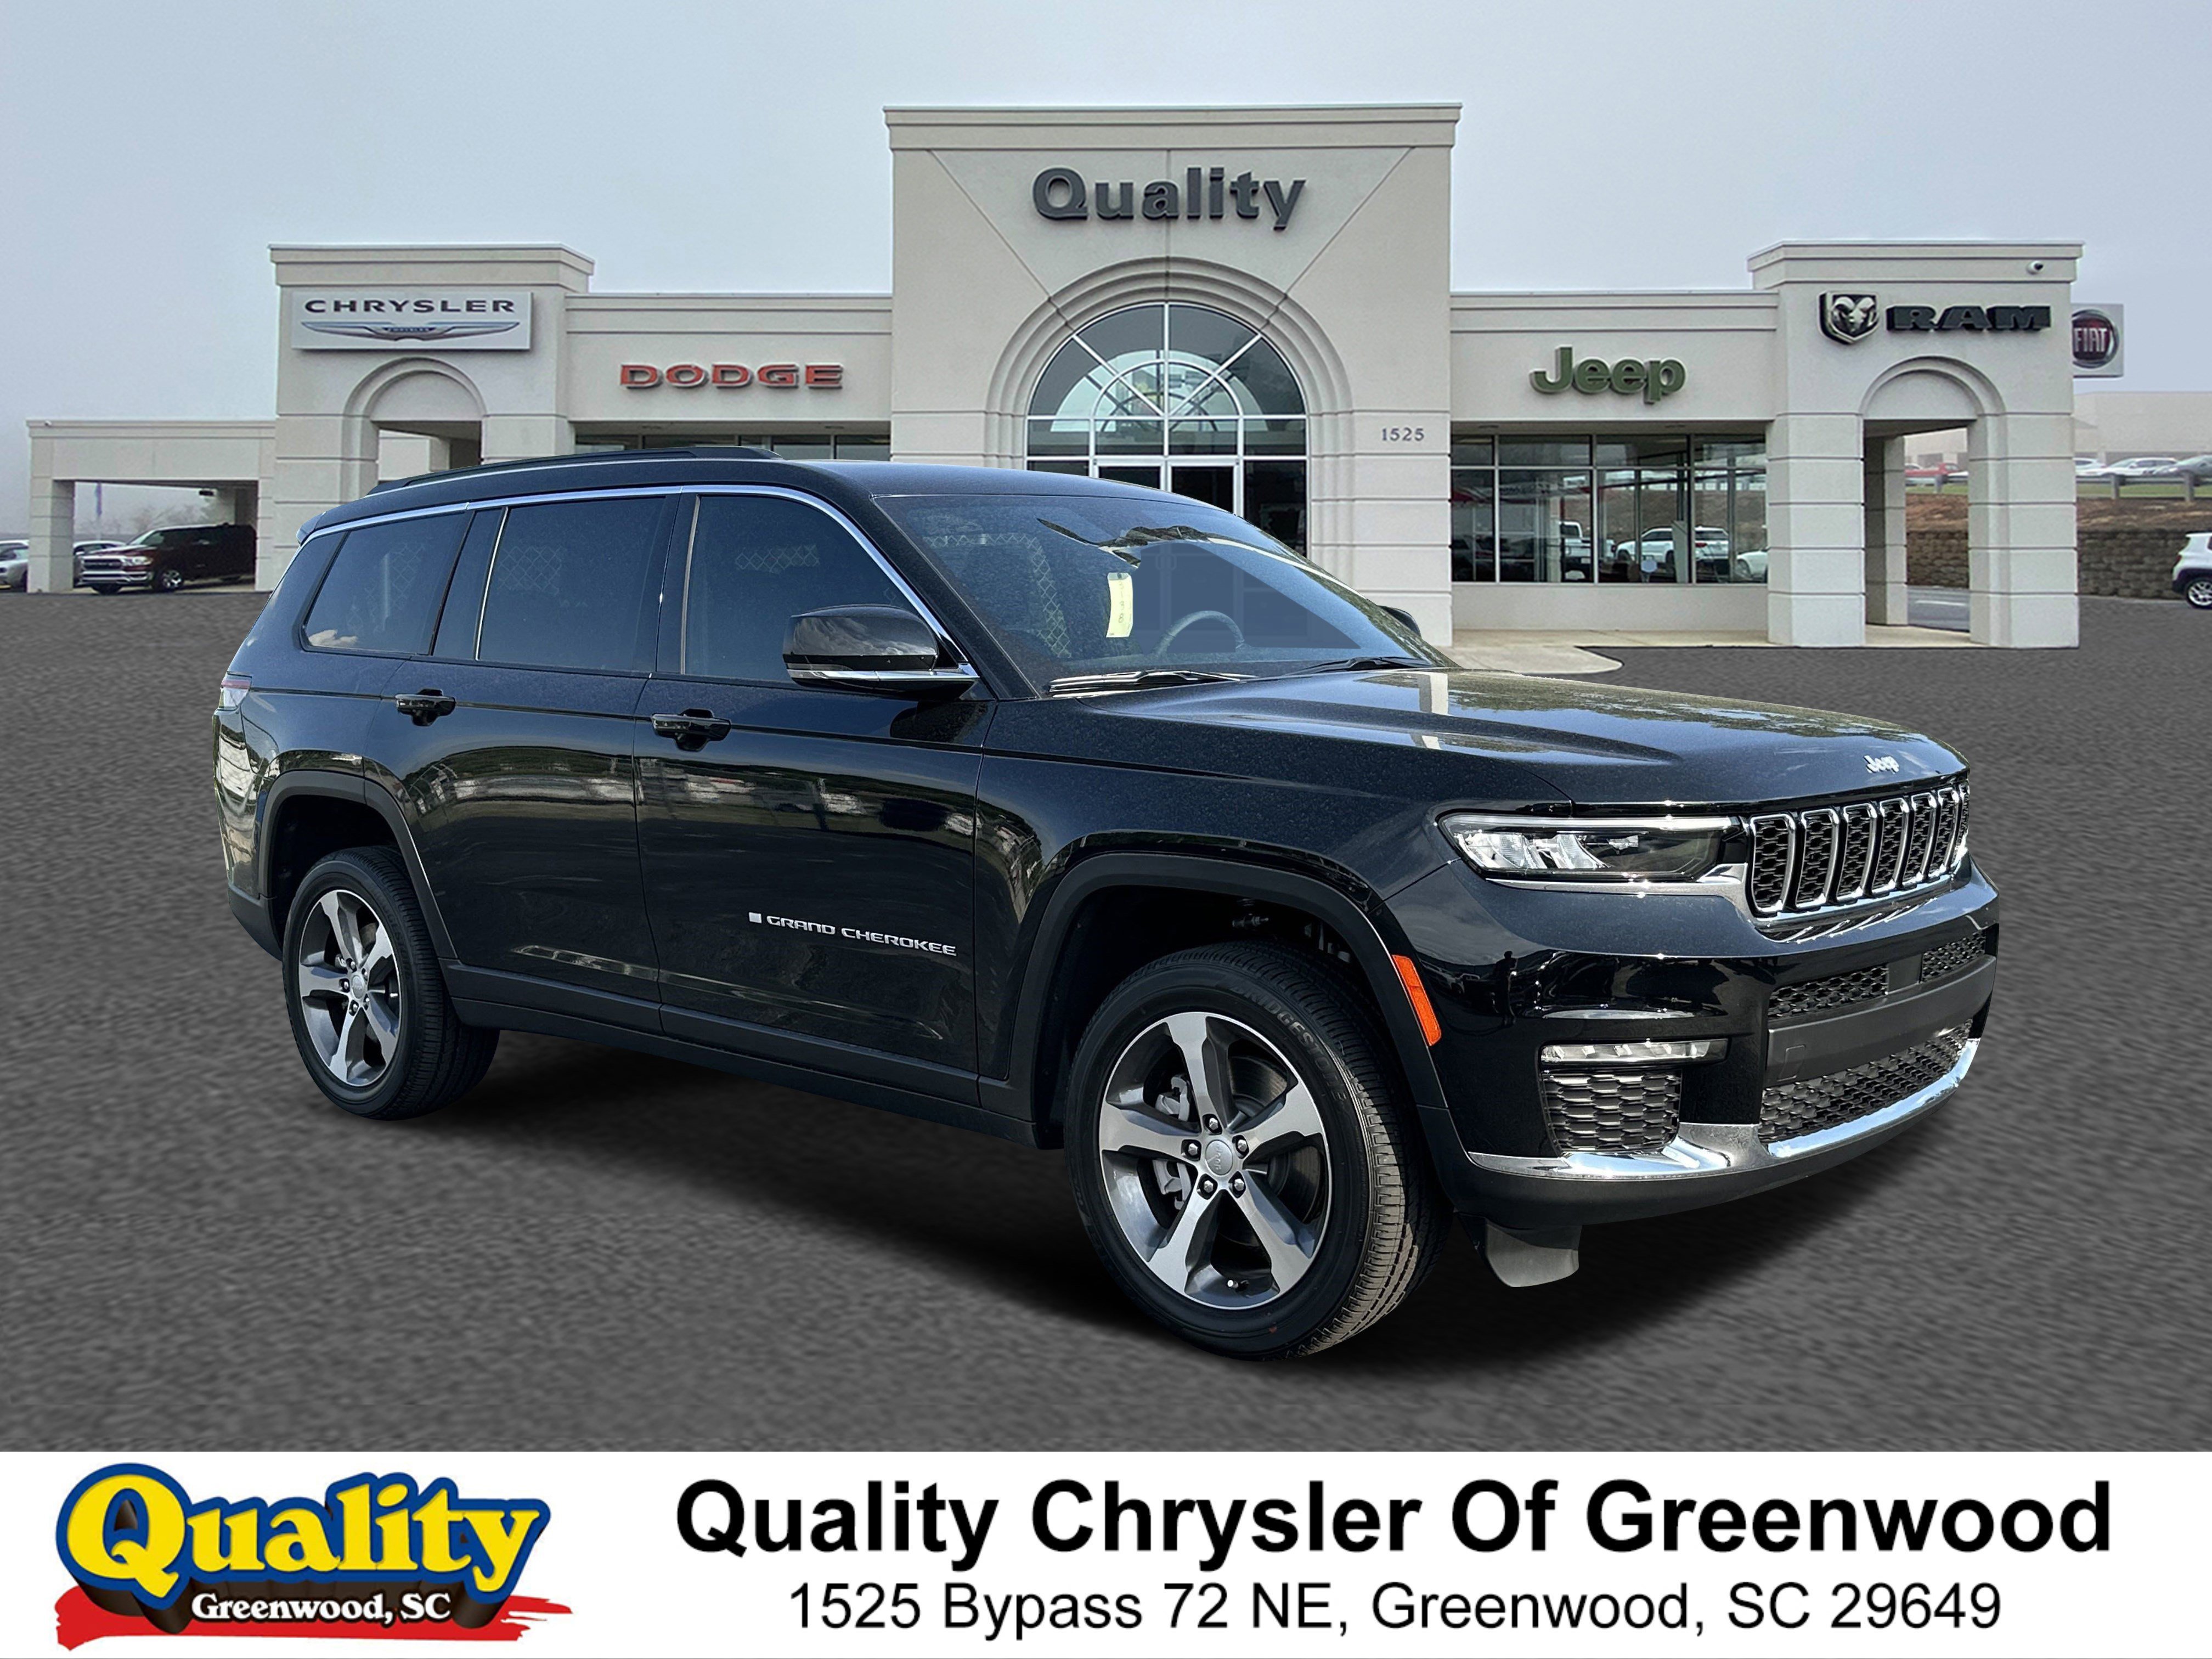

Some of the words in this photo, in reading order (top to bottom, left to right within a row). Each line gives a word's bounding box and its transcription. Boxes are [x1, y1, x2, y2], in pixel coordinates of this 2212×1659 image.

[1032, 166, 1306, 230] Quality
[304, 300, 515, 313] CHRYSLER
[1886, 305, 2051, 331] RAM
[2074, 328, 2107, 352] FIAT
[620, 363, 844, 390] DODGE
[1529, 346, 1686, 405] Jeep
[1382, 427, 1425, 441] 1525
[1863, 755, 1899, 775] Jeep
[766, 915, 836, 935] GRAND
[841, 928, 957, 956] CHEROKEE
